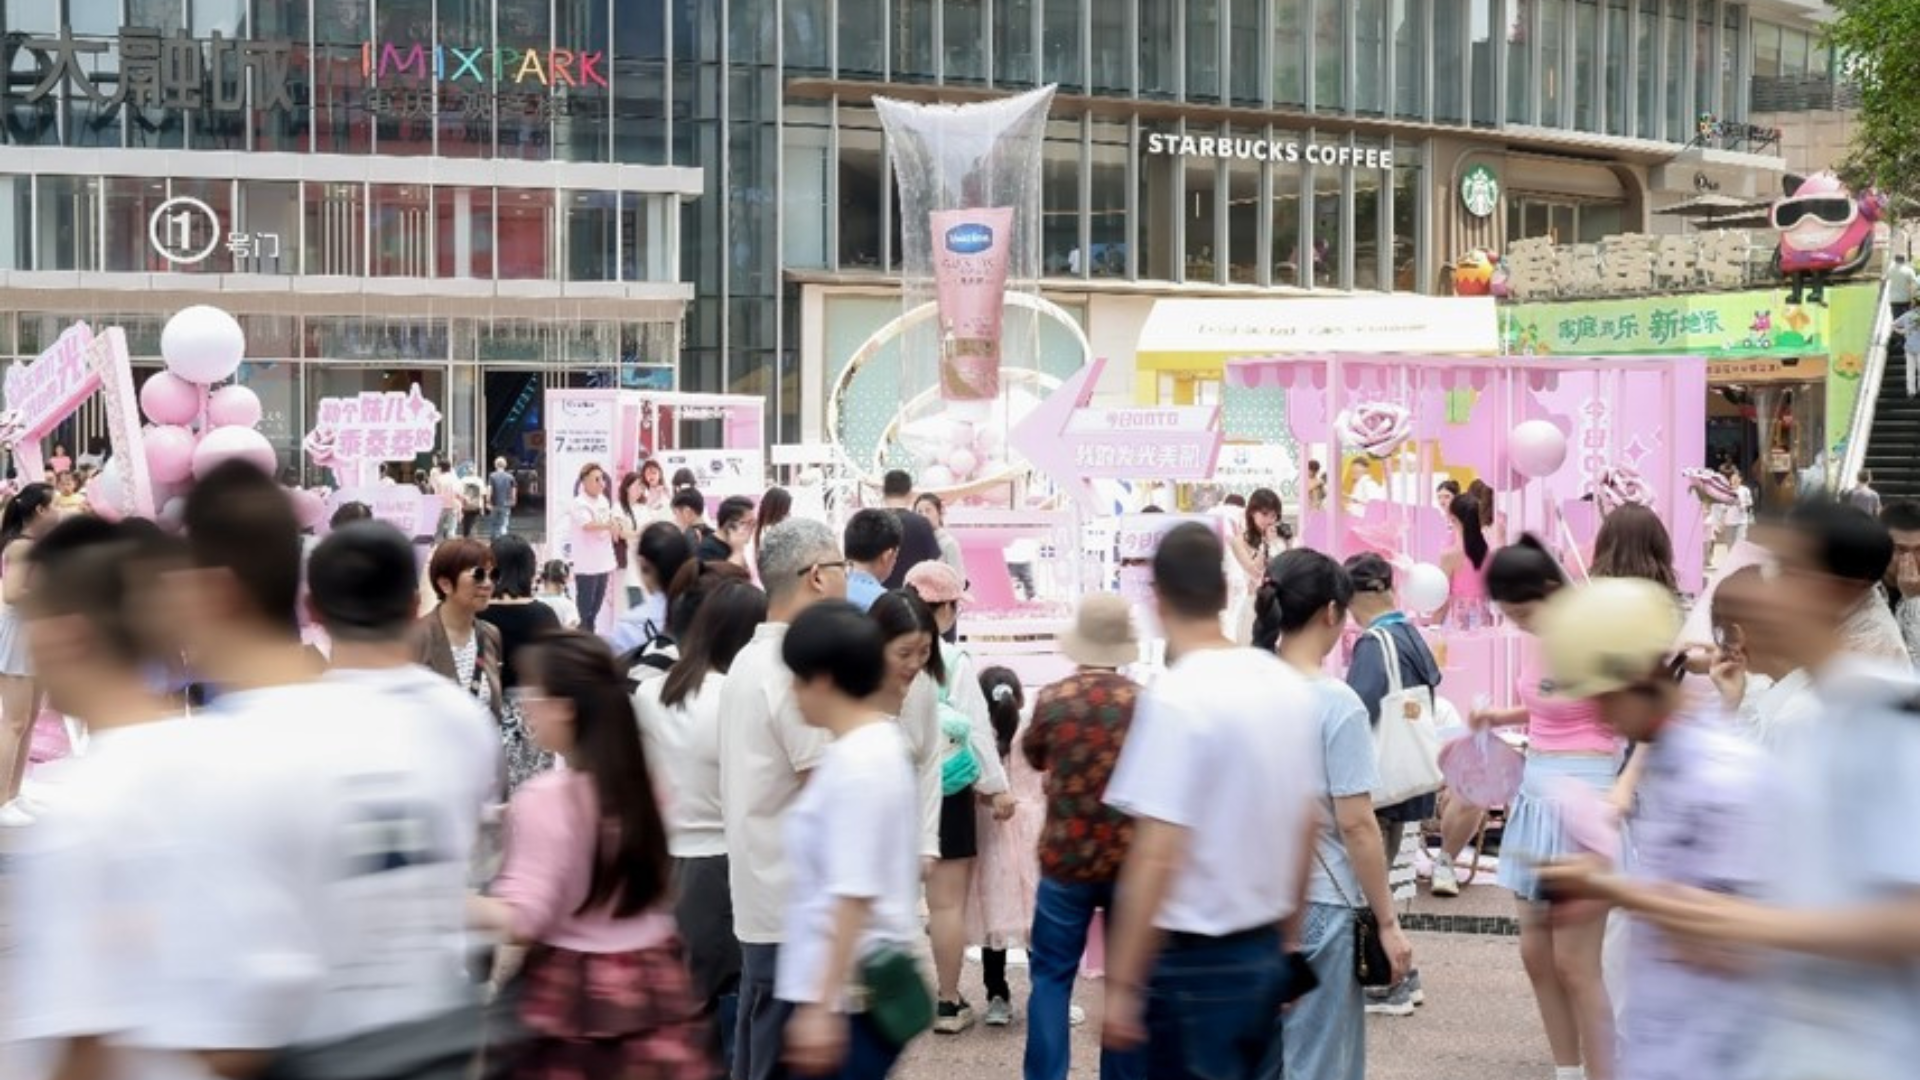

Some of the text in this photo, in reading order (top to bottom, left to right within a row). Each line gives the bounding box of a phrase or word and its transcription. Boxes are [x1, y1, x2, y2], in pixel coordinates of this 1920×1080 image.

[24, 27, 296, 111] 大融城
[1148, 133, 1393, 169] STARBUCKS COFFEE
[225, 232, 279, 258] 号门
